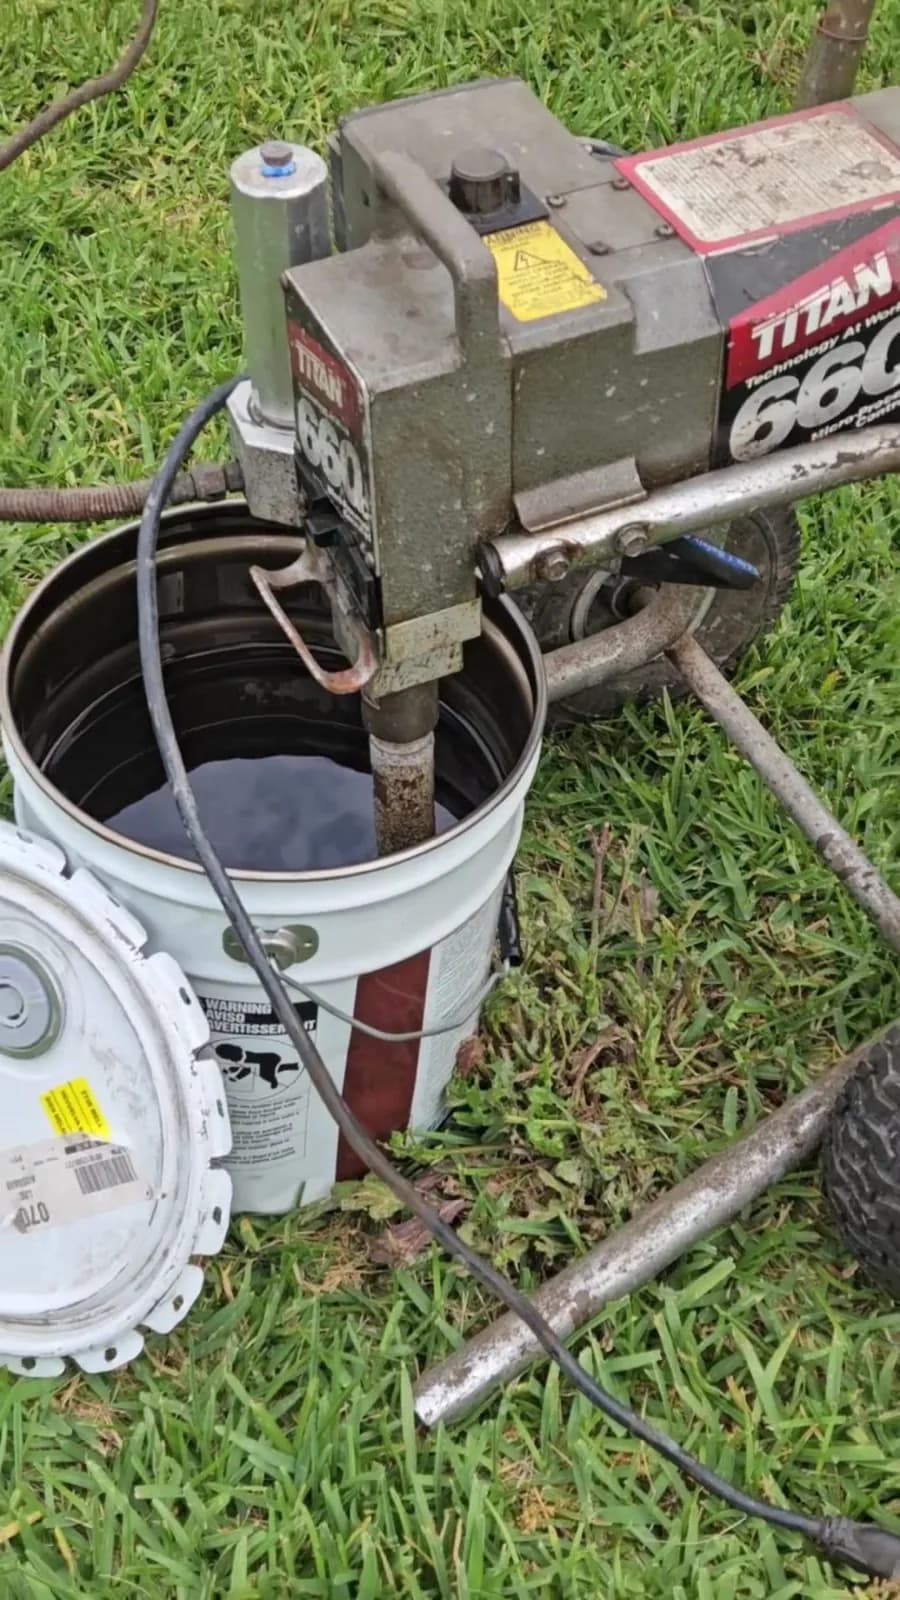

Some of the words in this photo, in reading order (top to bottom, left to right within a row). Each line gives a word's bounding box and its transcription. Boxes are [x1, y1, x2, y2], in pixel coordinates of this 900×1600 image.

[752, 251, 892, 361] TITAN
[292, 335, 346, 408] TITAN
[729, 315, 900, 461] 660
[745, 336, 840, 389] Technology
[842, 322, 862, 340] At
[205, 999, 272, 1015] WARNING
[205, 1009, 246, 1024] AVISO
[209, 1019, 316, 1034] AVERTISSEMT
